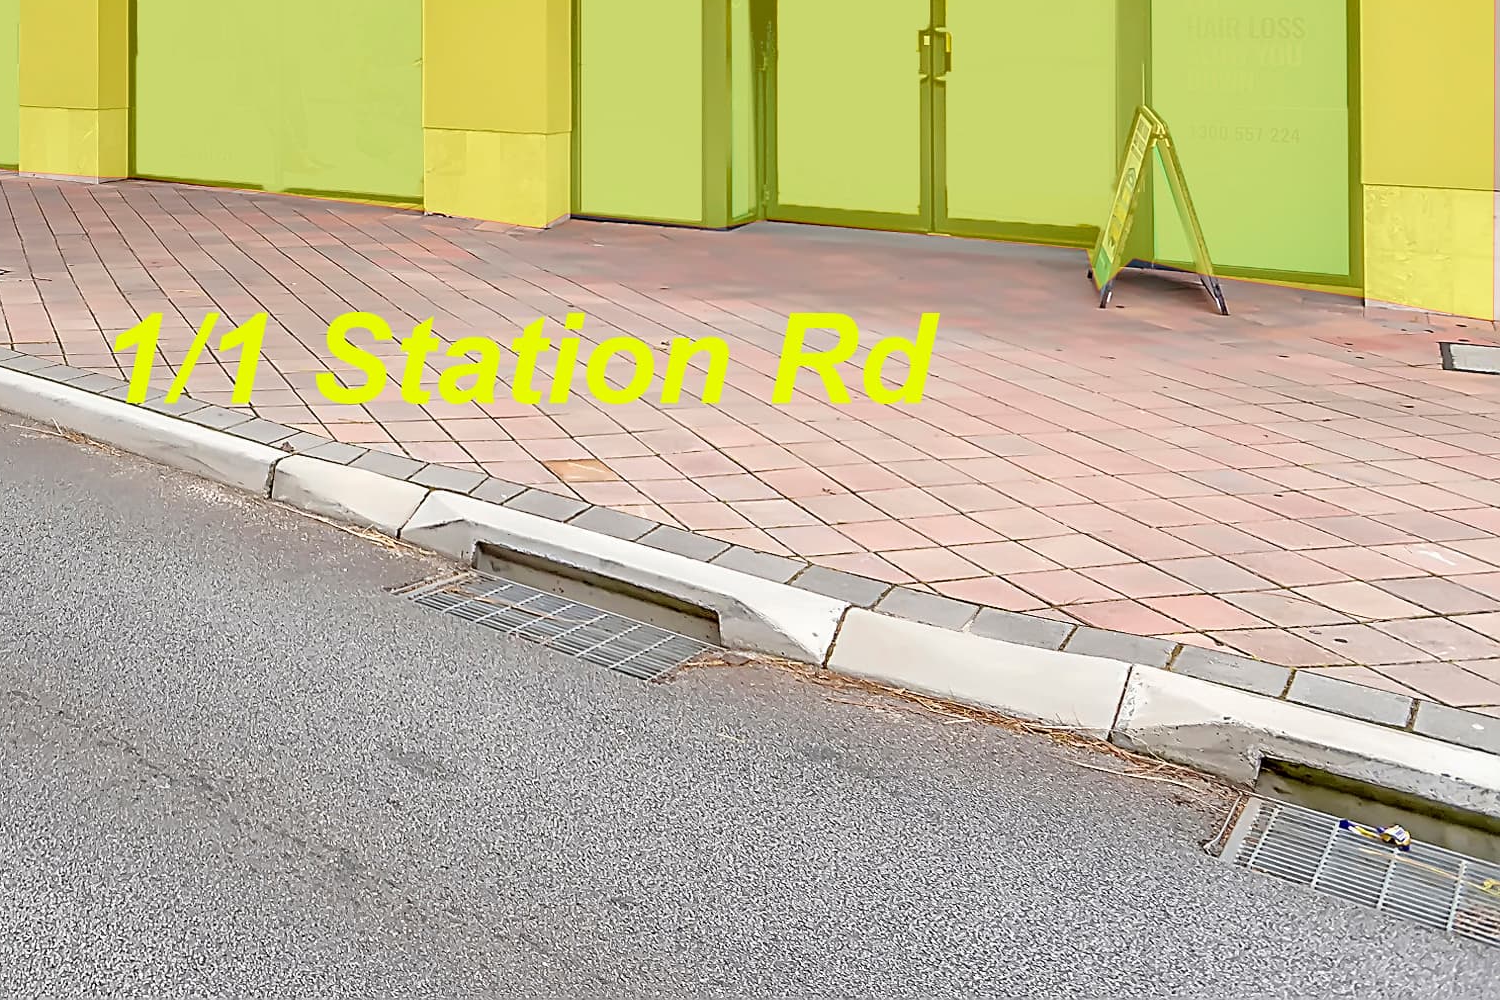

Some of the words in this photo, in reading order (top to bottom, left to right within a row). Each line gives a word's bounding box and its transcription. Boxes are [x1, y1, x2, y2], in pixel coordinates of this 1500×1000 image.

[1187, 15, 1240, 41] HAIR
[1248, 15, 1306, 40] LOSS
[1269, 126, 1301, 145] 224
